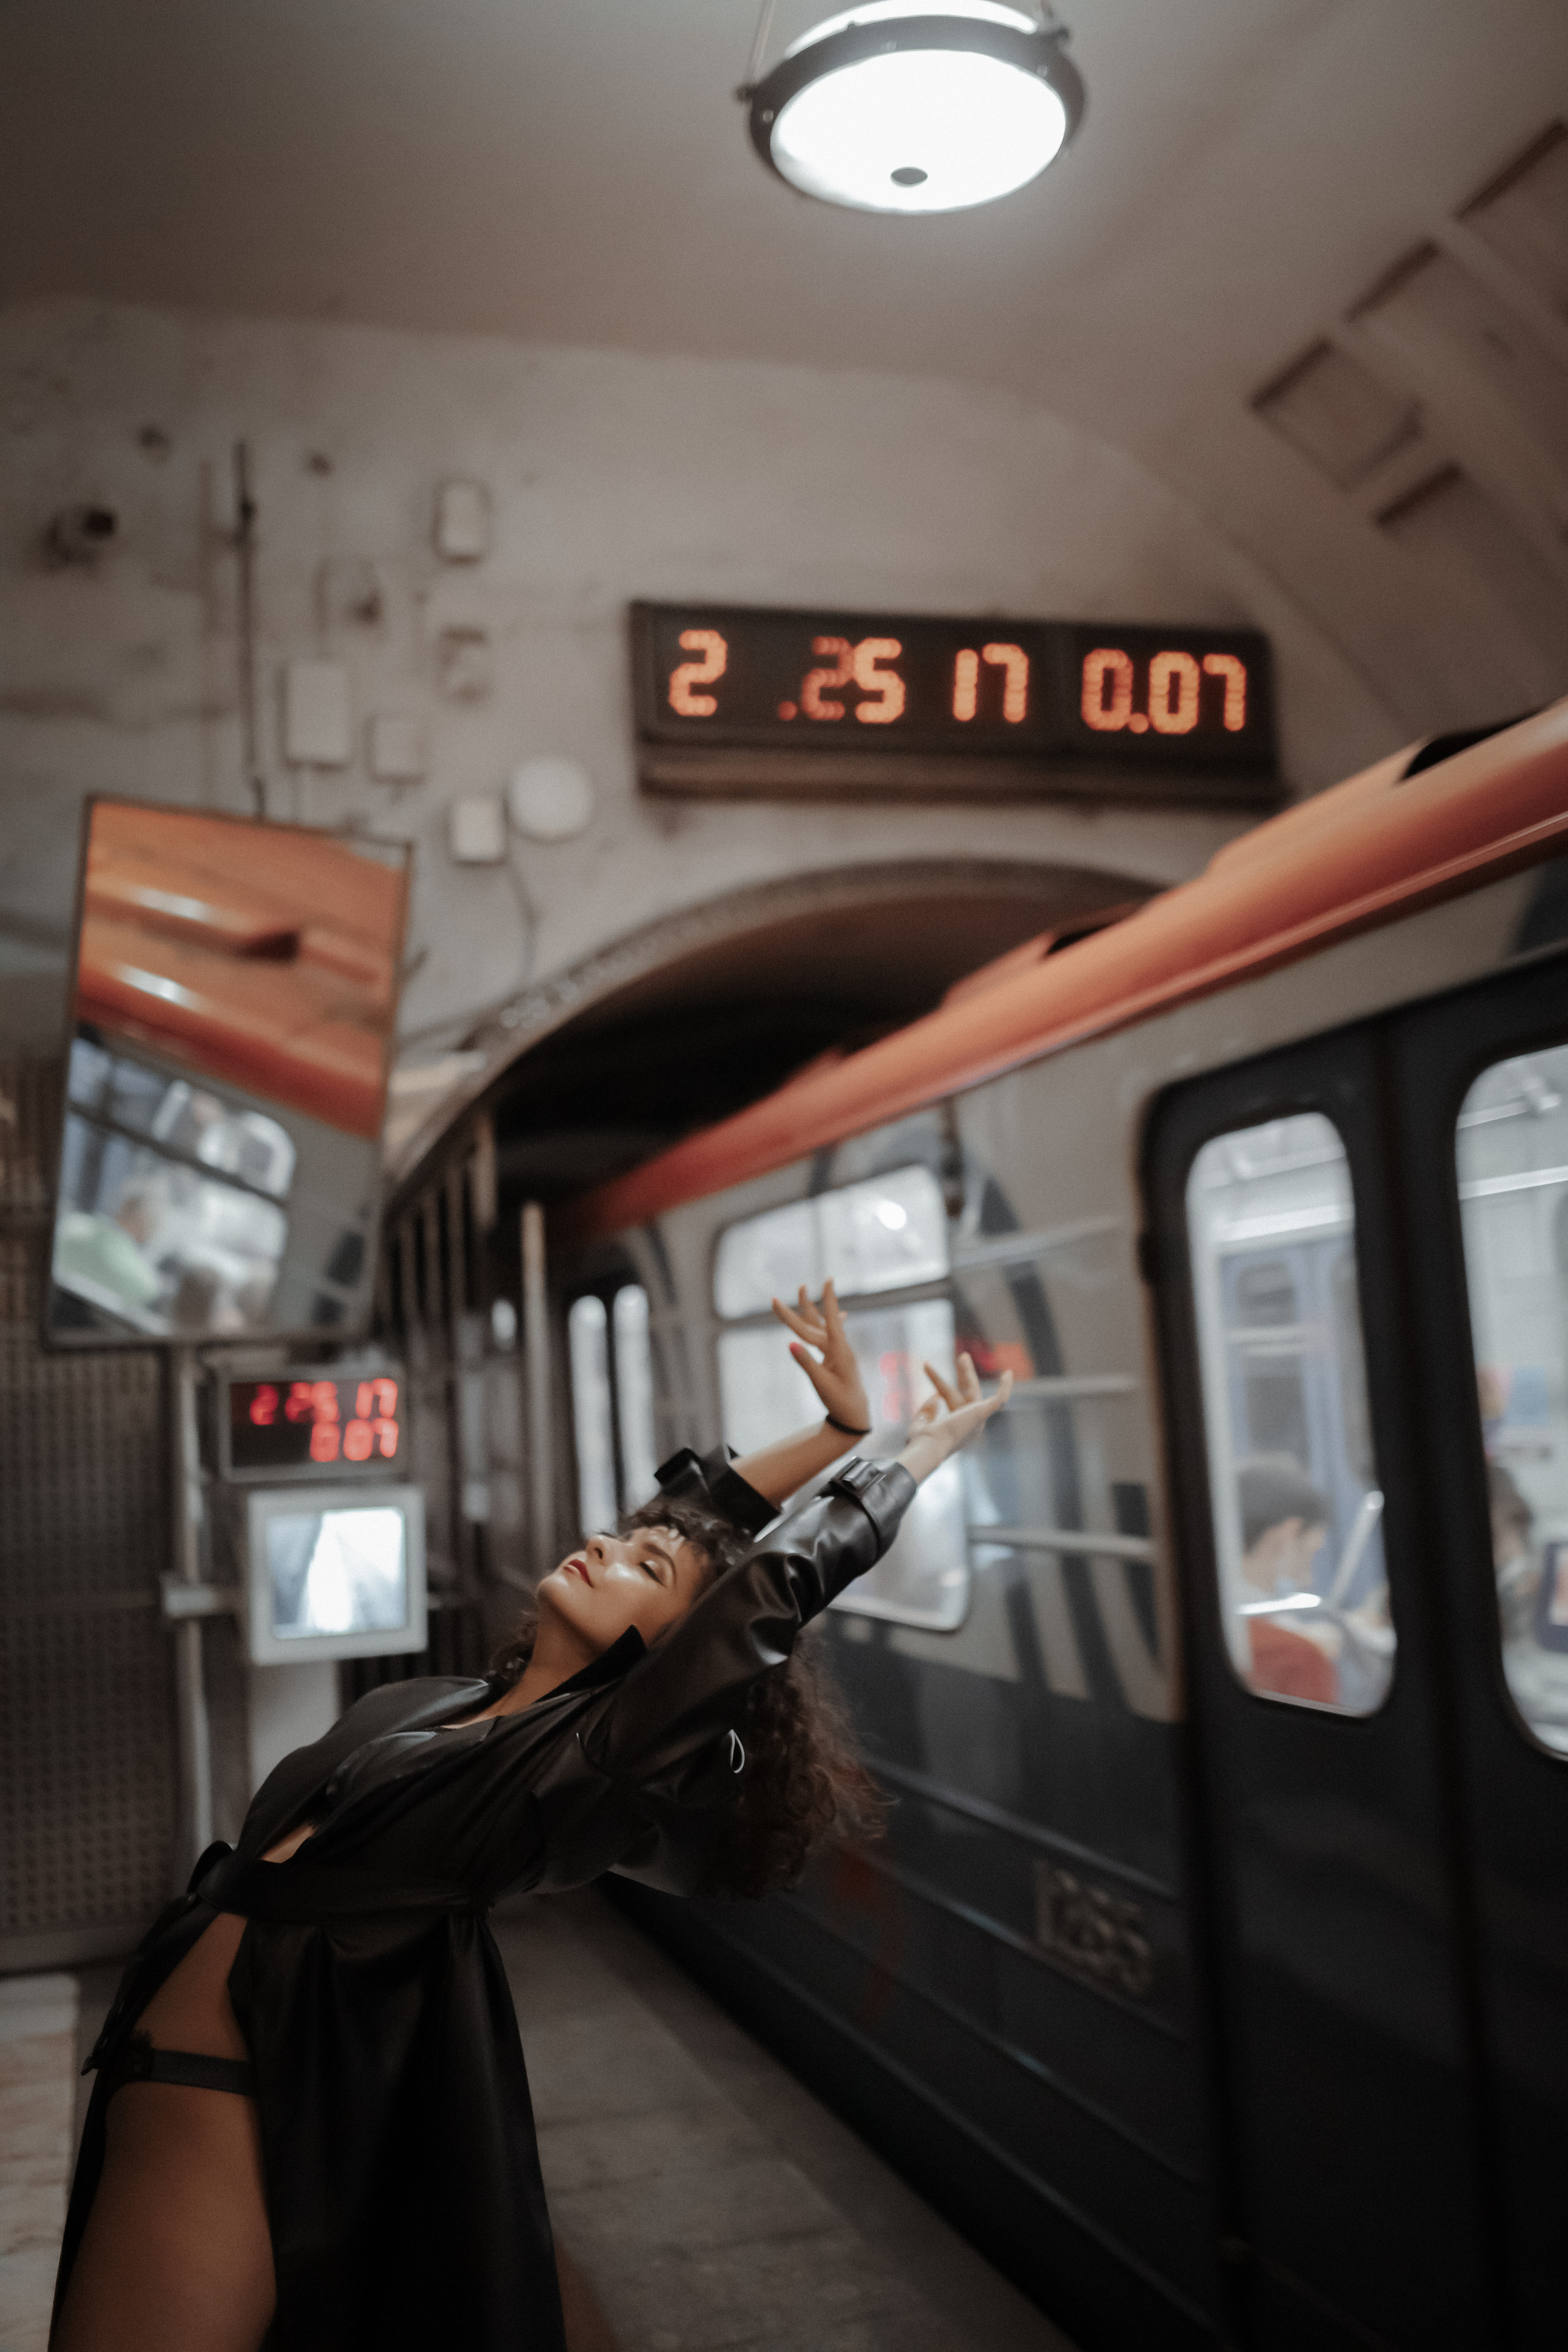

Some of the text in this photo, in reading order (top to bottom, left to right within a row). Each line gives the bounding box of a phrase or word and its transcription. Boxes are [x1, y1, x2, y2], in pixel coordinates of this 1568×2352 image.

[668, 629, 728, 716] 2
[952, 643, 1030, 723] 17
[1081, 648, 1246, 734] 0.07
